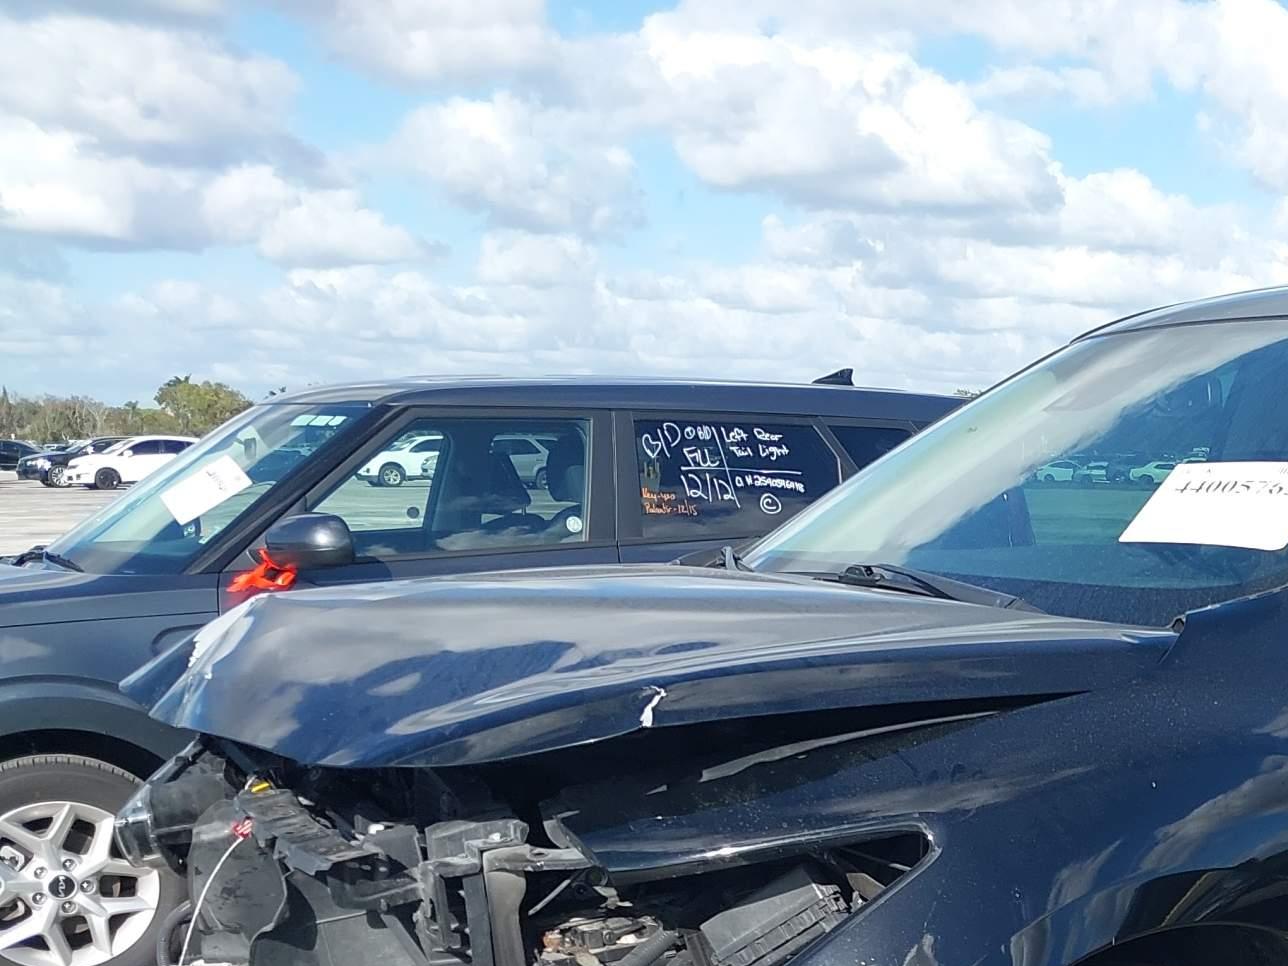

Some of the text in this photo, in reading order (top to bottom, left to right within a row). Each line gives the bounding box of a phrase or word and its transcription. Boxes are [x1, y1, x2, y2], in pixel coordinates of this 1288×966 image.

[721, 426, 783, 443] Left Rear
[729, 443, 790, 461] Tail Light
